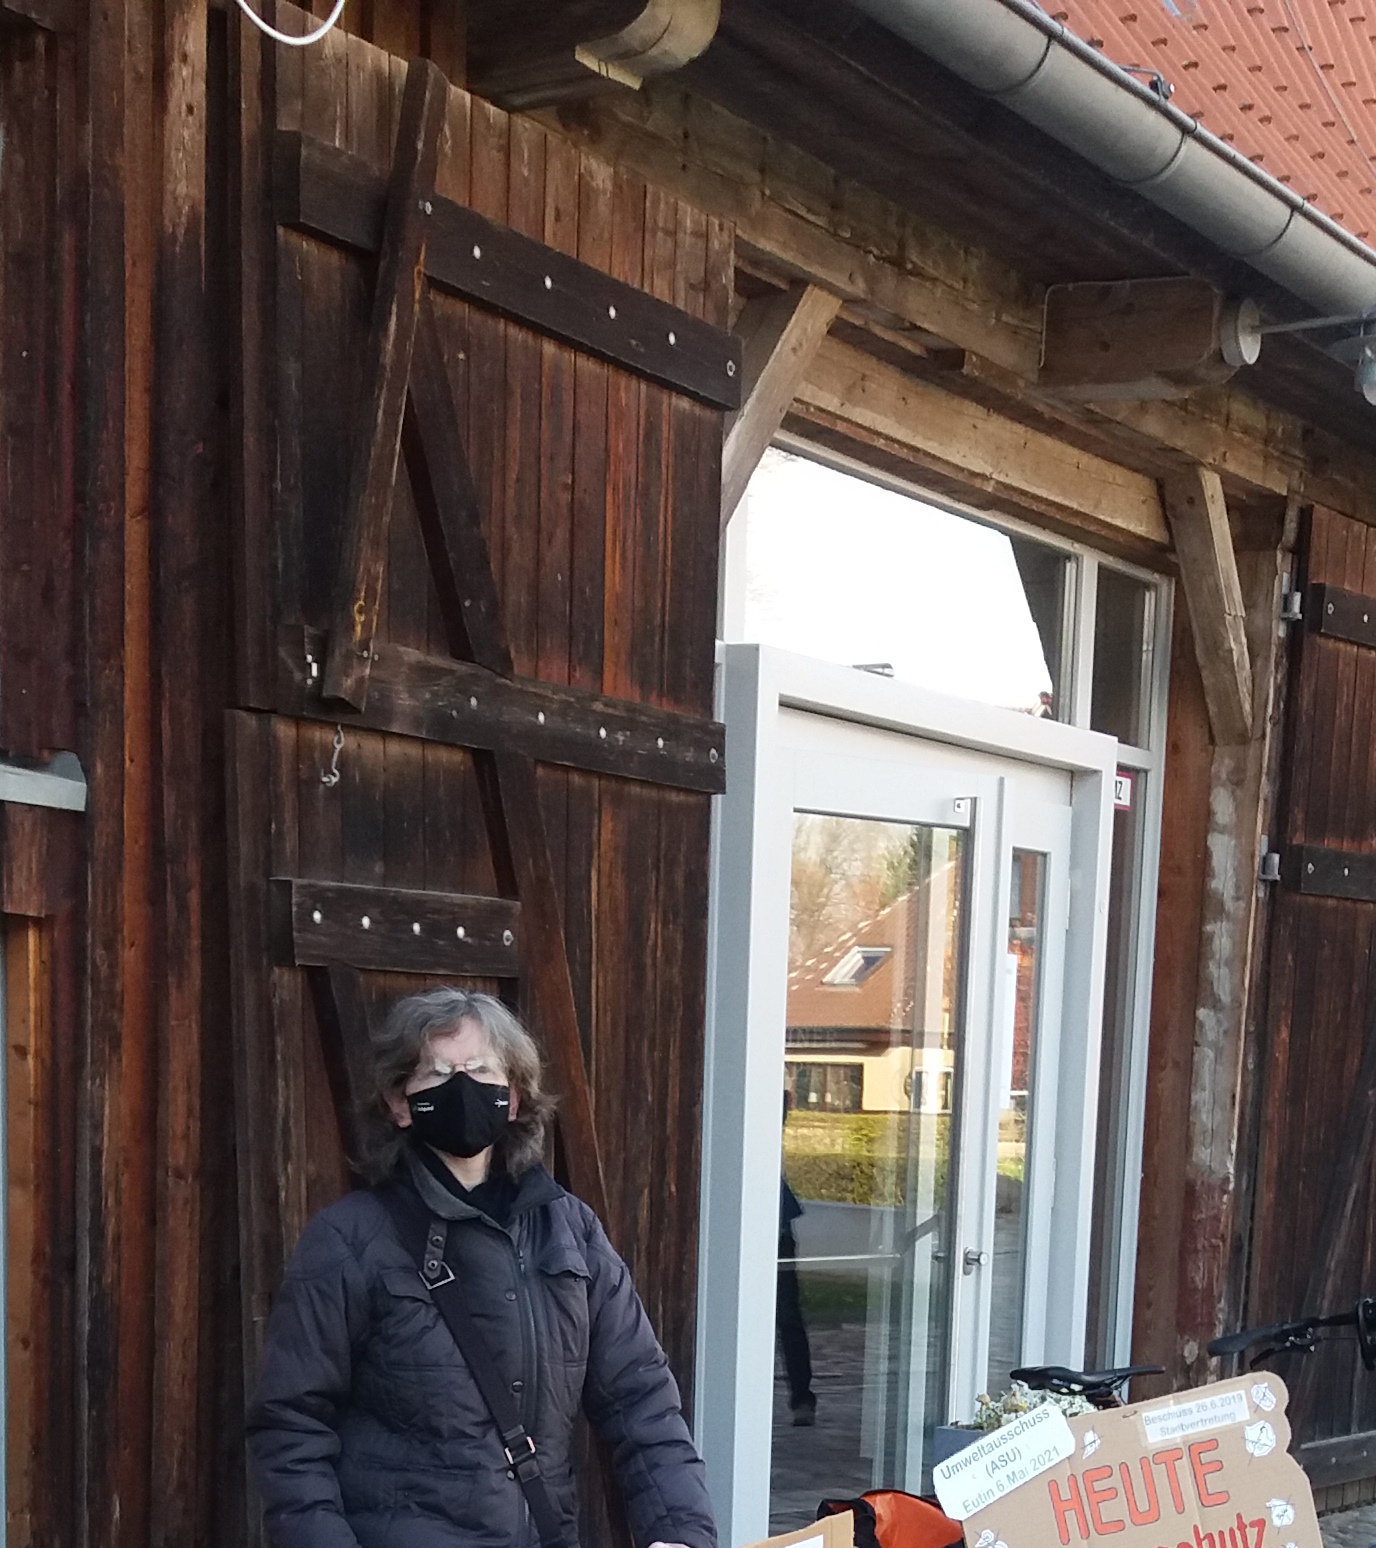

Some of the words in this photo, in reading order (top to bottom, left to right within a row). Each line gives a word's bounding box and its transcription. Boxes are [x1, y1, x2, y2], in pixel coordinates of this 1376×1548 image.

[1144, 1408, 1193, 1427] Beschluss
[1195, 1393, 1244, 1415] 26.6.2019
[1159, 1411, 1237, 1438] Stadtvertretung
[940, 1408, 1050, 1480] Umweltausschuss
[985, 1446, 1023, 1479] (ASU)
[962, 1488, 996, 1514] Eutin
[1029, 1445, 1061, 1473] 2021
[1047, 1438, 1230, 1546] HEUTE
